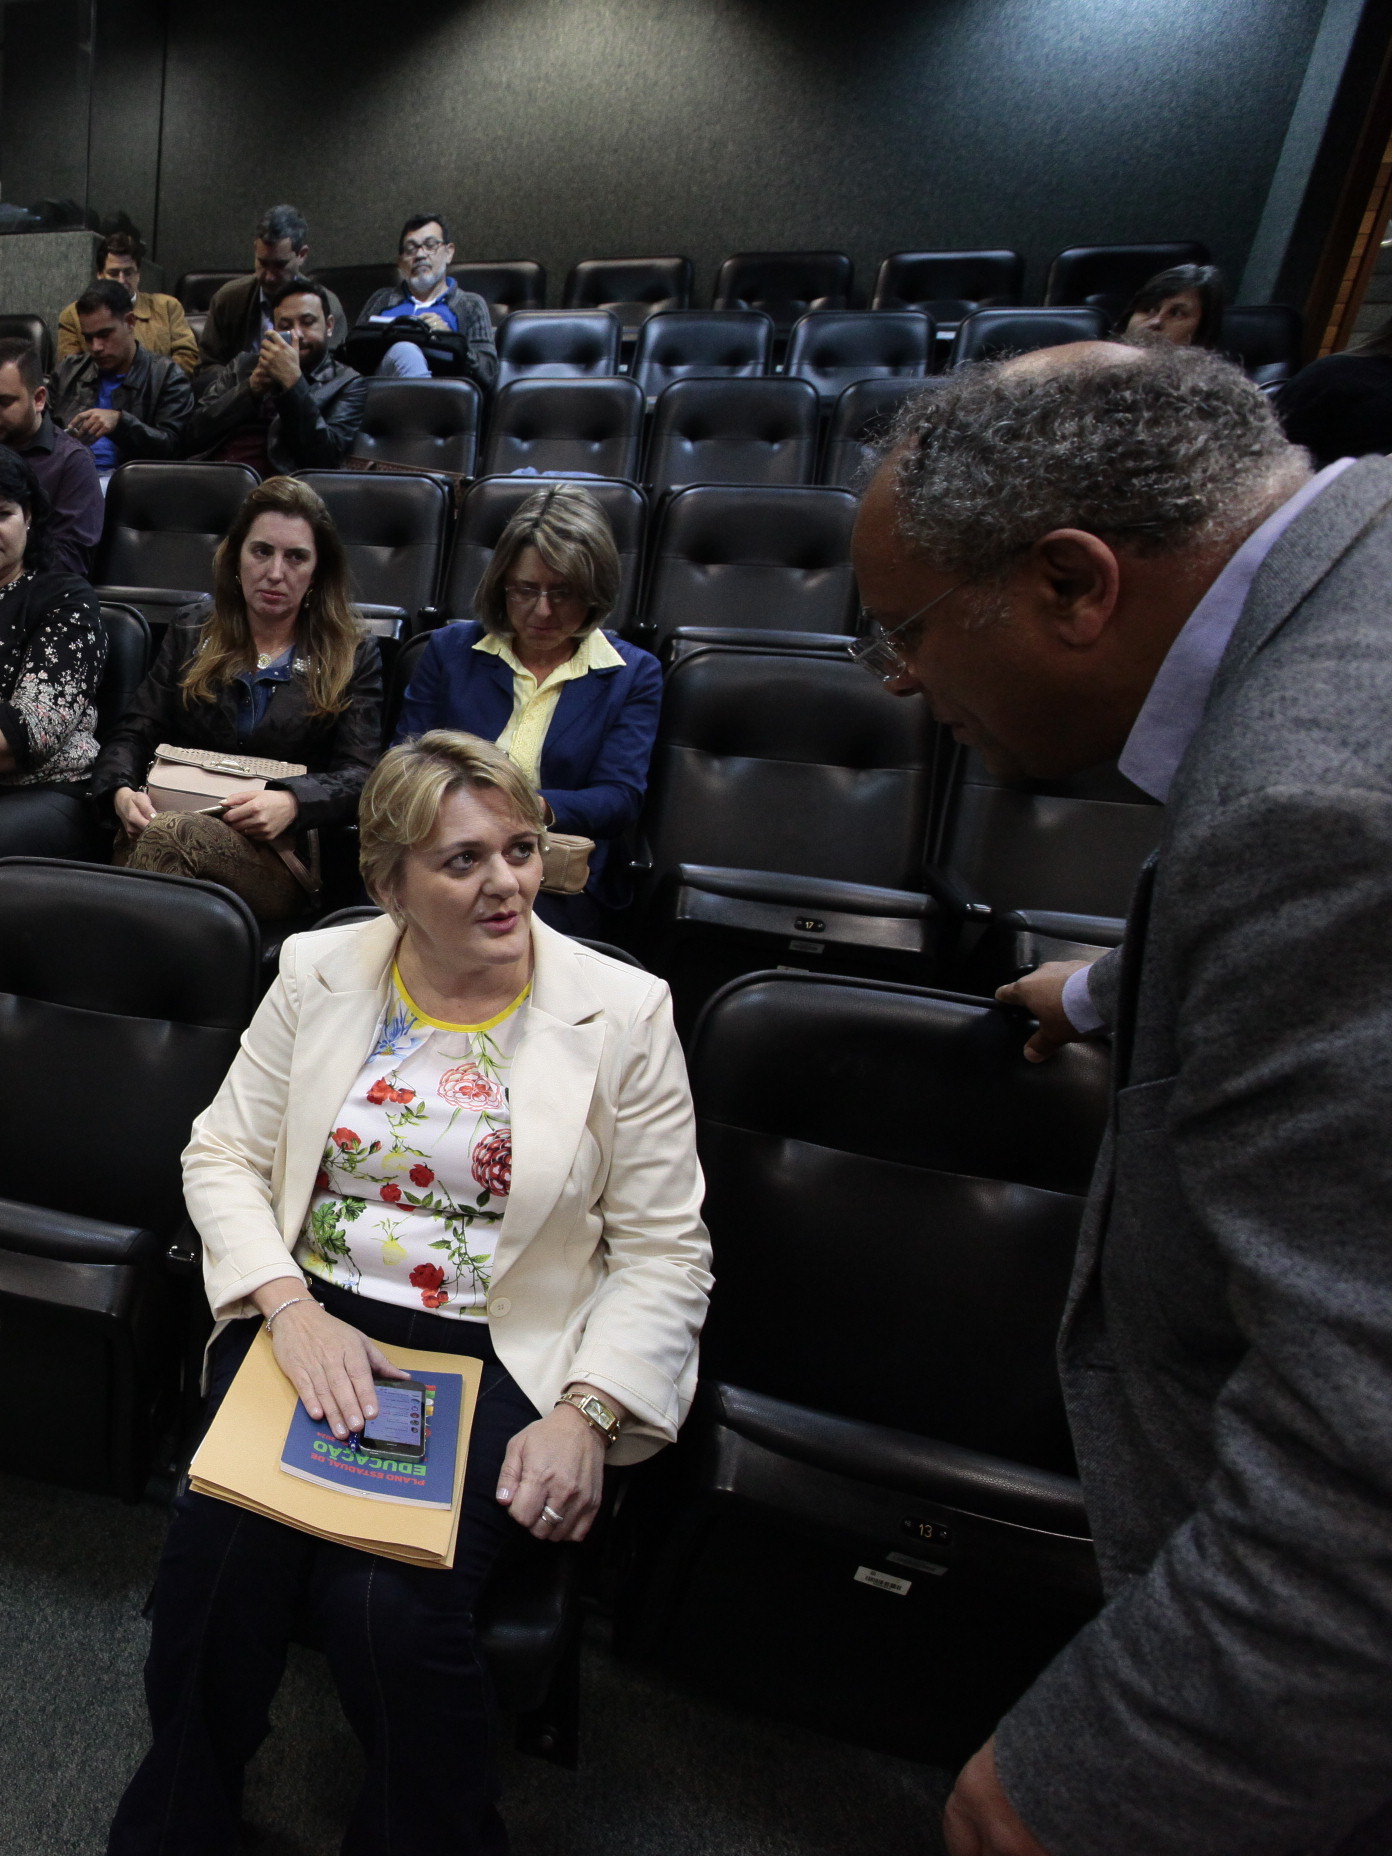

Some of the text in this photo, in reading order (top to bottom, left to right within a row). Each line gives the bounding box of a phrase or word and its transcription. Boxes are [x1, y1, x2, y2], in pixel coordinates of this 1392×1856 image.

[805, 921, 814, 929] 17
[310, 1452, 427, 1487] PLANO ESTADUAL DE
[312, 1440, 428, 1477] EDUCAÇÃO
[918, 1523, 933, 1539] 13
